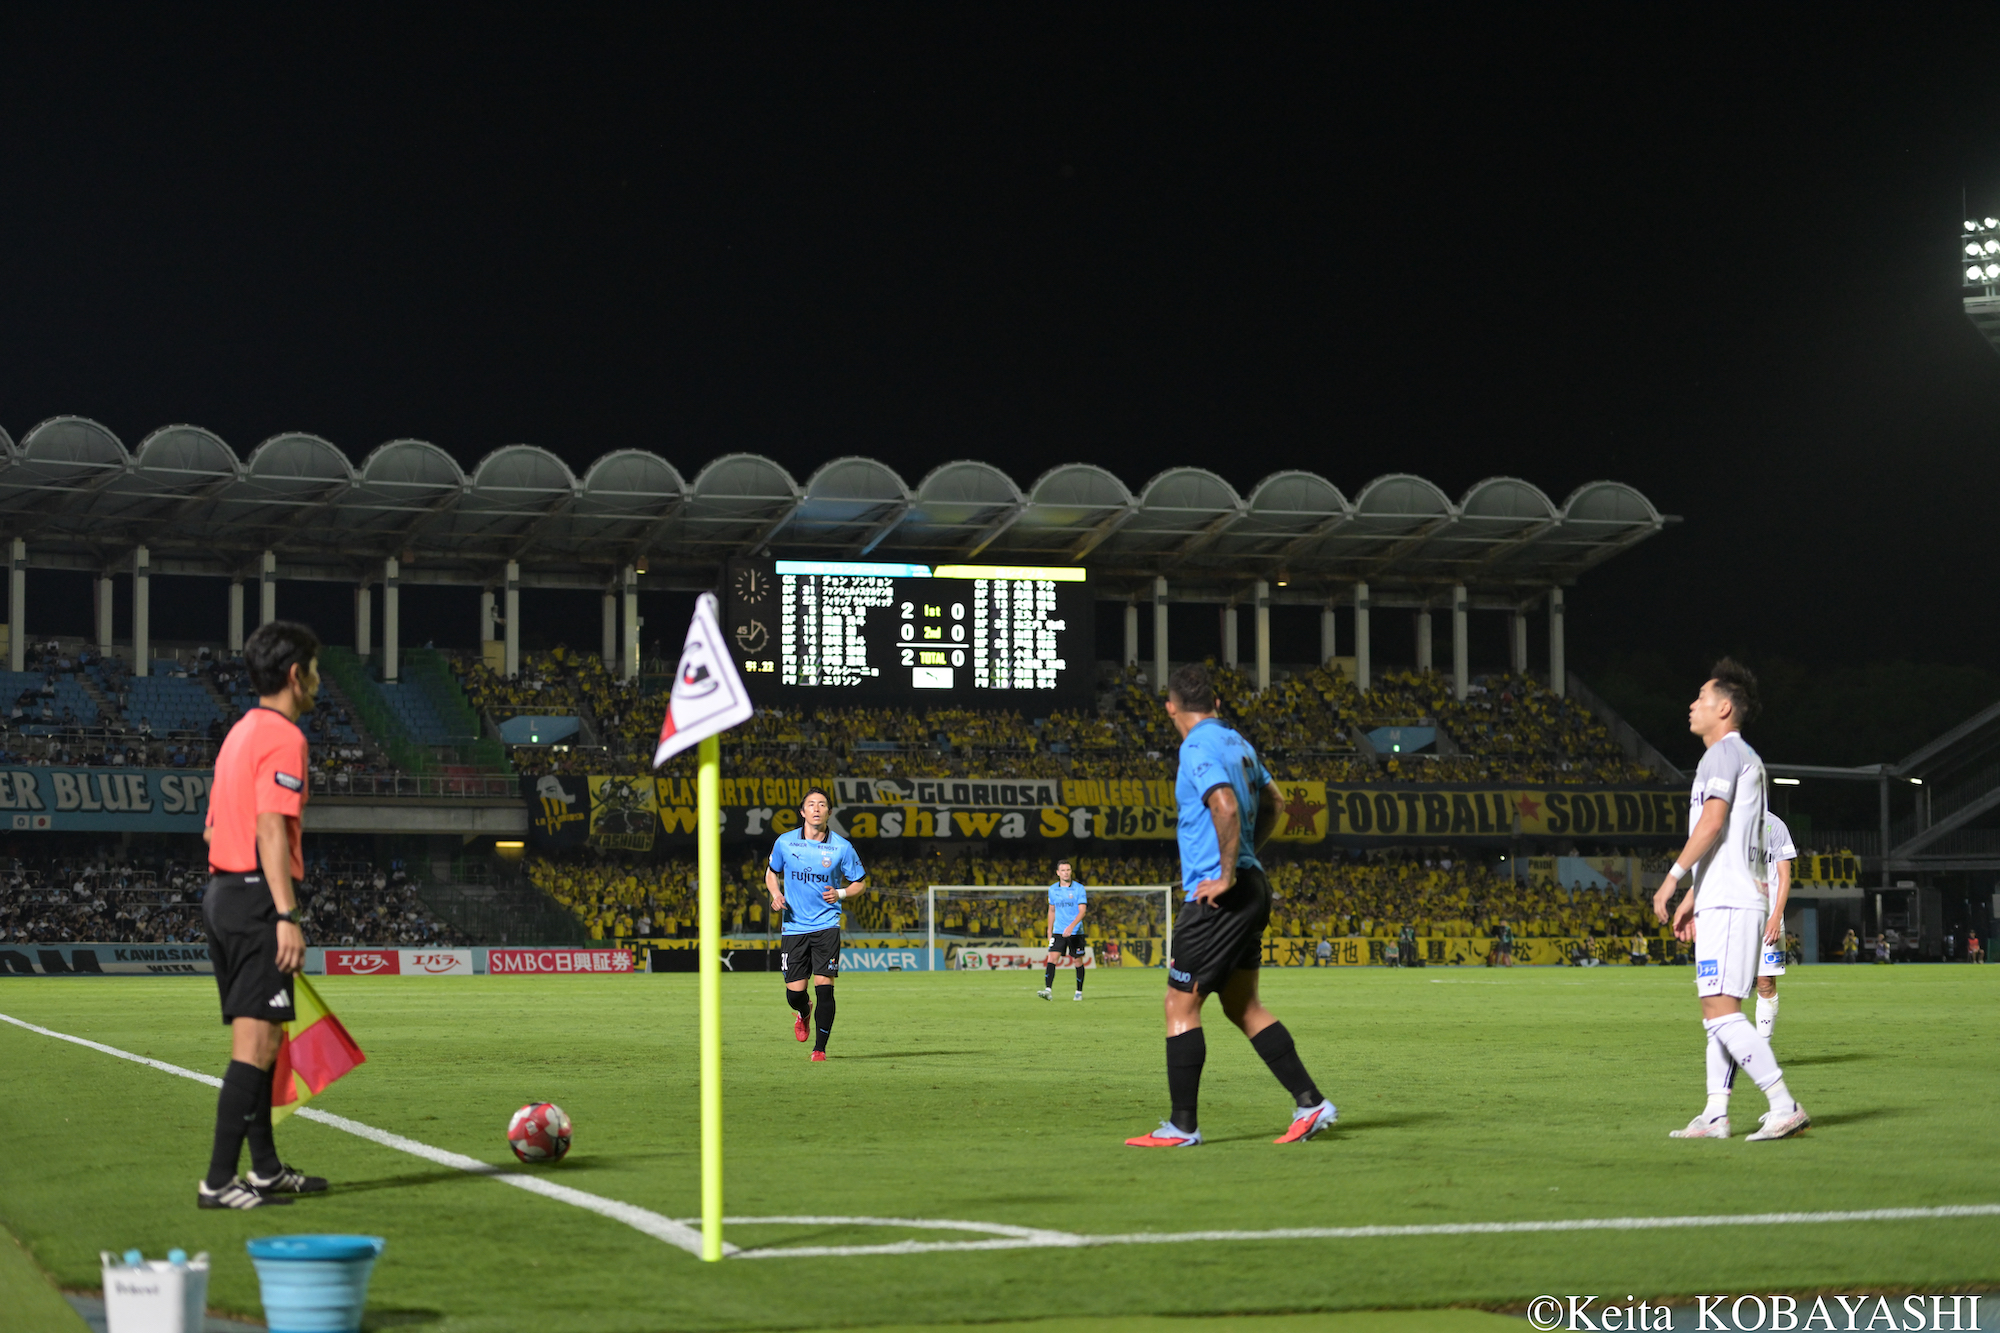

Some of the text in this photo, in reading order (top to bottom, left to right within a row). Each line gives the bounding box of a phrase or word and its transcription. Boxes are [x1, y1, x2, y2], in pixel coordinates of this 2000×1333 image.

[810, 576, 814, 584] 1
[803, 586, 814, 594] 31
[803, 596, 816, 604] 22
[996, 600, 1007, 609] 13
[901, 602, 965, 620] 2 1st 0
[1001, 610, 1007, 618] 2
[736, 626, 748, 634] 45
[901, 623, 914, 641] 0
[951, 624, 965, 642] 0
[804, 636, 816, 645] 14
[804, 656, 816, 665] 17
[901, 648, 965, 667] 2 TOTAL 0
[996, 659, 1008, 668] 14
[0, 771, 44, 811] ER
[51, 773, 152, 813] BLUE
[719, 777, 761, 806] IRTY
[838, 781, 1054, 806] LA GLORIOSA
[1062, 778, 1145, 807] ENDLESS
[1286, 788, 1308, 798] NO
[1327, 791, 1513, 835] FOOTBALL
[656, 806, 728, 836] W
[1039, 804, 1101, 839] St
[590, 834, 653, 850] ASHIWA
[792, 870, 829, 884] FUJITSU
[114, 949, 211, 961] KAWASAK
[492, 952, 631, 972] SMBC日興証券
[838, 952, 918, 970] ANKER
[146, 964, 198, 973] WITH
[338, 954, 389, 974] エバラ
[412, 954, 462, 973] エバラ
